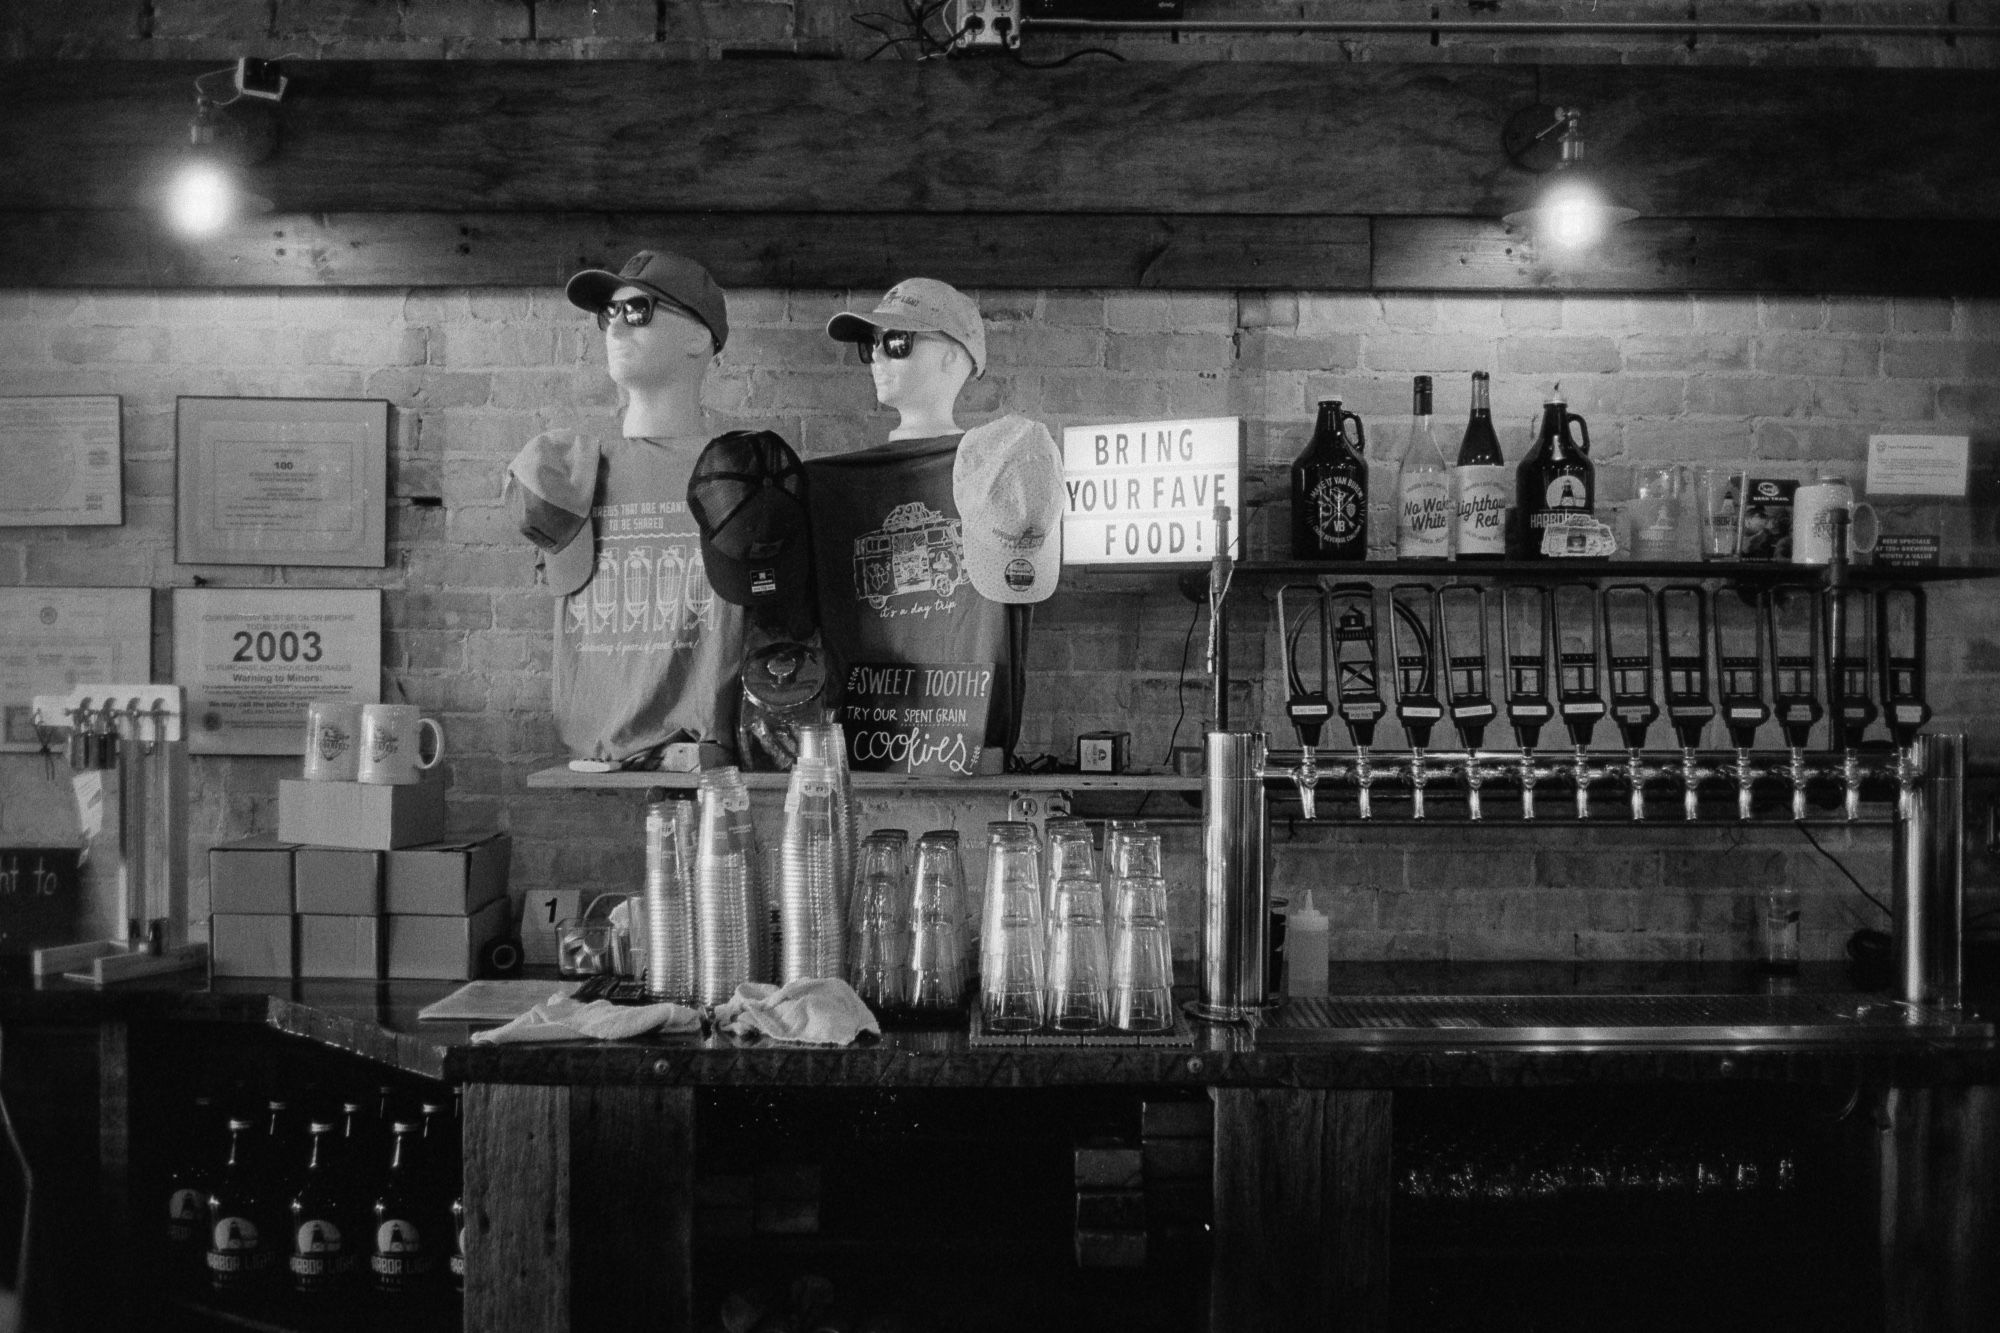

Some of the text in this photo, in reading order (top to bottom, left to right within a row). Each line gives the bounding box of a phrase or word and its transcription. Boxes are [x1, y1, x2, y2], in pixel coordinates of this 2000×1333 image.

[1095, 428, 1193, 466] BRING
[1333, 476, 1347, 485] VAN
[1066, 473, 1225, 512] YOUR FAVE
[621, 503, 638, 516] THAT
[641, 502, 656, 514] ARE
[660, 500, 687, 513] MEANT
[1404, 494, 1452, 516] No Wak
[609, 516, 664, 531] TO BE SHARED
[1333, 520, 1346, 532] VB
[1411, 512, 1446, 531] White
[1475, 510, 1499, 529] Red
[1105, 521, 1202, 556] FOOD!
[910, 602, 931, 619] day
[934, 598, 957, 614] trip
[233, 631, 323, 662] 2003
[232, 674, 273, 684] Warning
[275, 674, 285, 683] to
[857, 667, 991, 697] SWEET TOOTH?
[847, 706, 966, 724] TRY OUR SPENT GRAIN
[33, 855, 58, 896] to
[544, 897, 557, 924] 1
[206, 1250, 241, 1272] ARBOR
[289, 1256, 324, 1275] ARBOR
[370, 1255, 402, 1275] ARBOR
